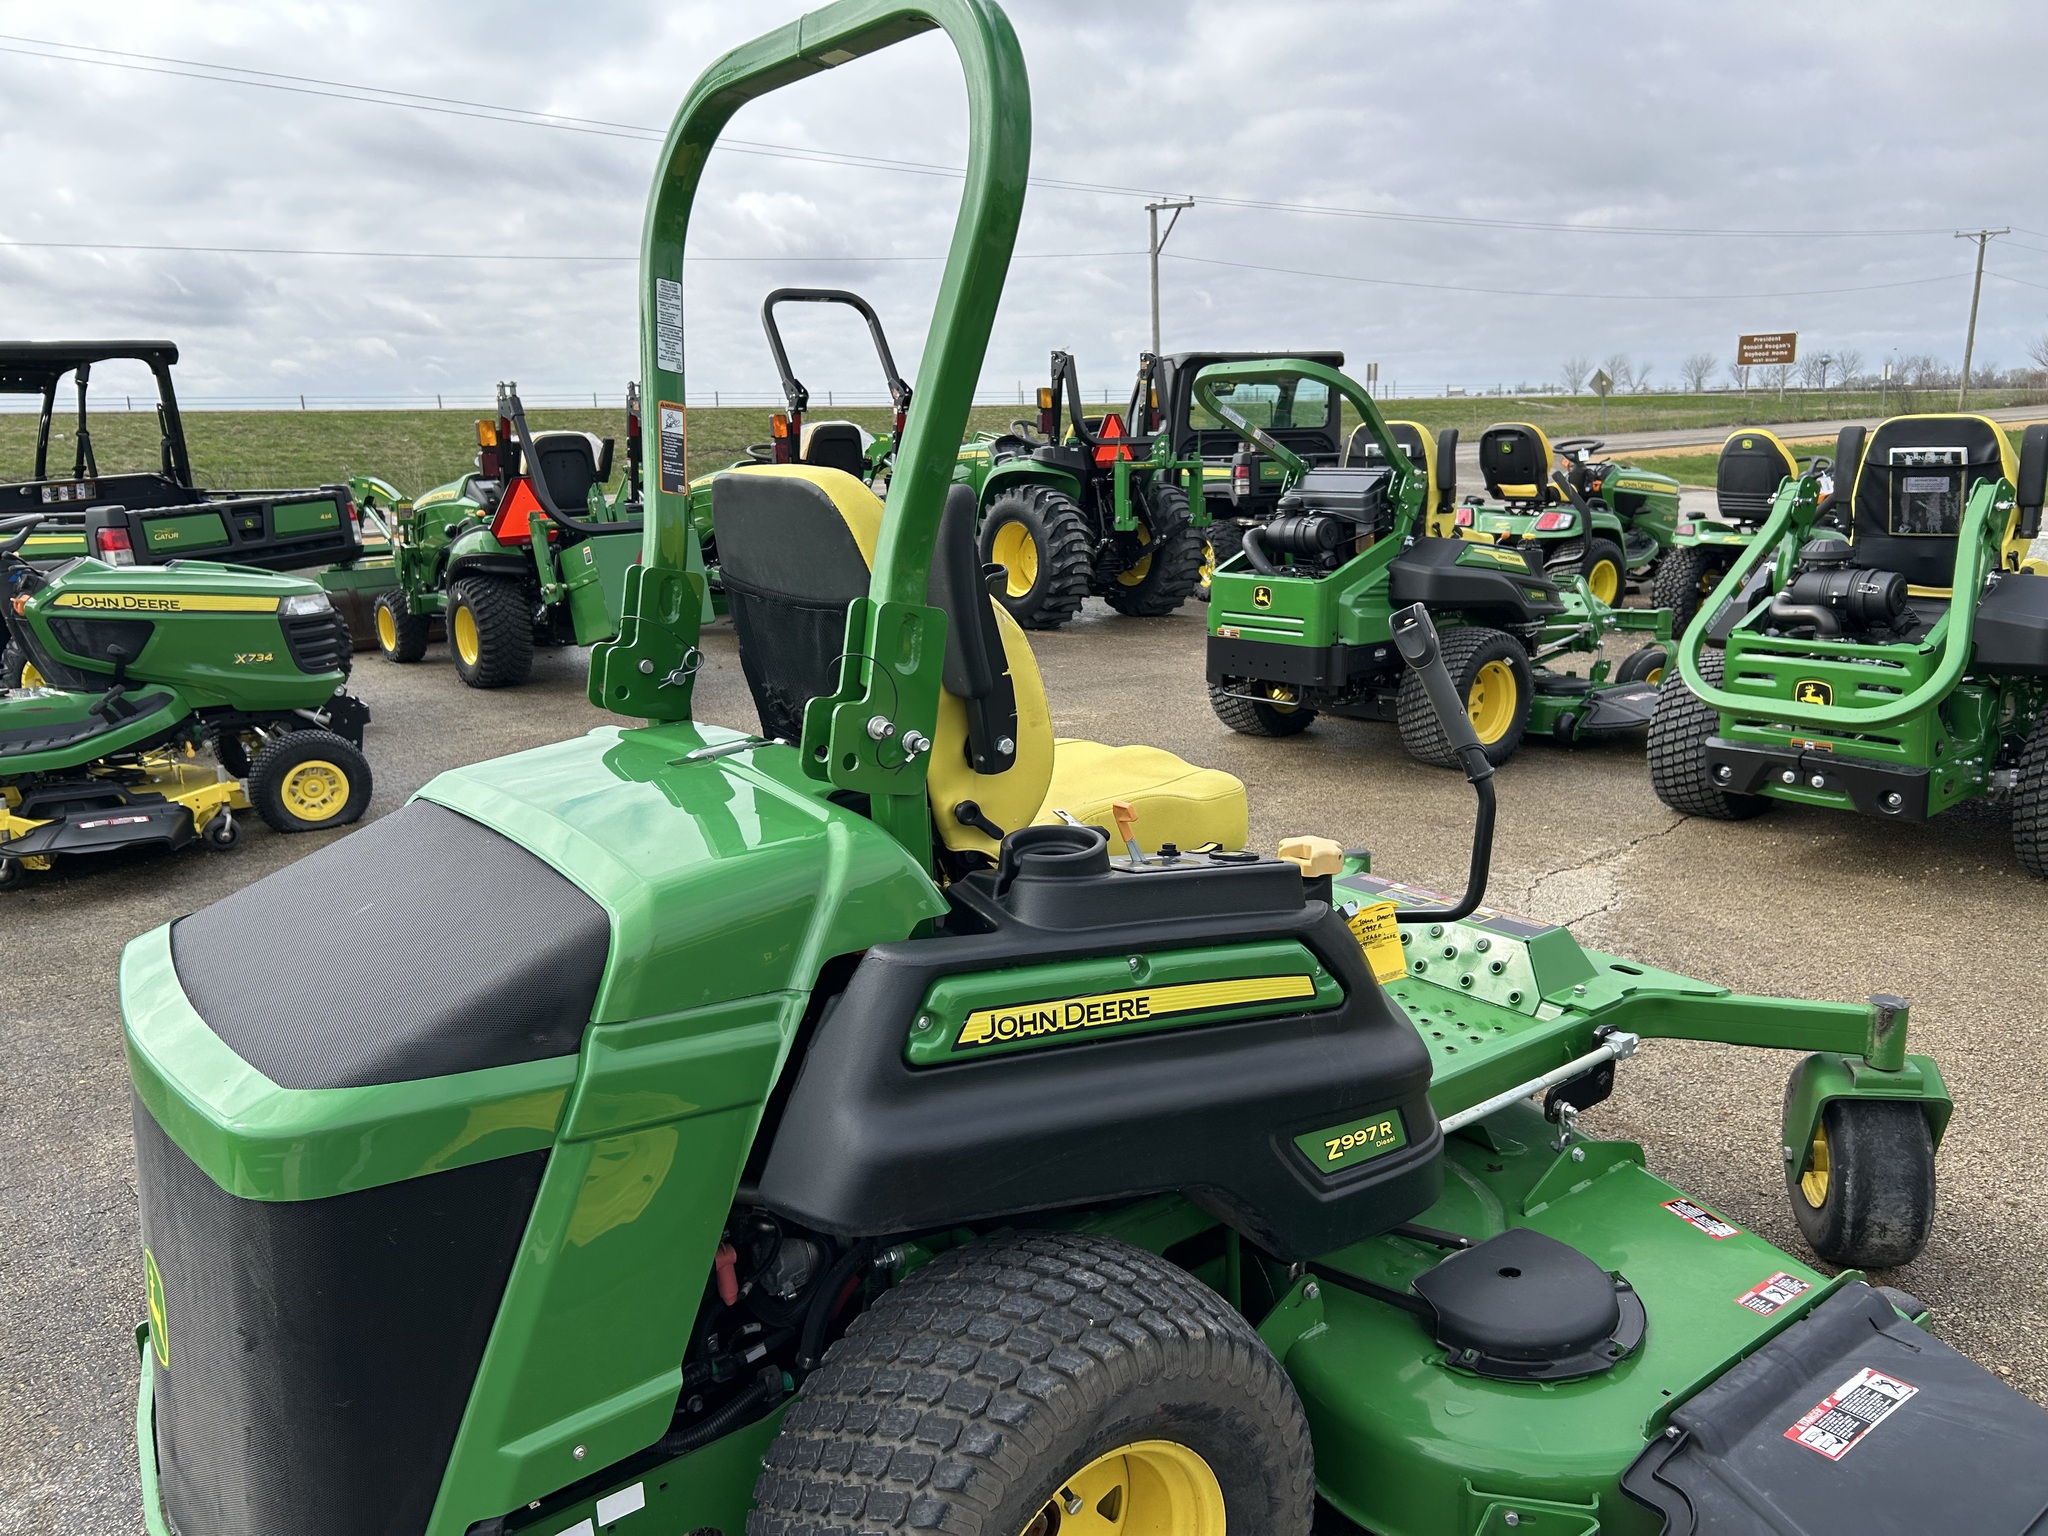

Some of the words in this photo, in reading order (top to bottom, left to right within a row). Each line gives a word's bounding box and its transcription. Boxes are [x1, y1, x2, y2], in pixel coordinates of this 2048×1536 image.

[1753, 335, 1782, 343] President
[154, 532, 178, 541] GATOR
[72, 595, 119, 607] JOHN
[123, 596, 181, 609] DEERE
[234, 653, 274, 664] X734
[980, 1009, 1057, 1040] JOHN
[1064, 996, 1150, 1025] DEERE
[1375, 1136, 1396, 1147] Diesel
